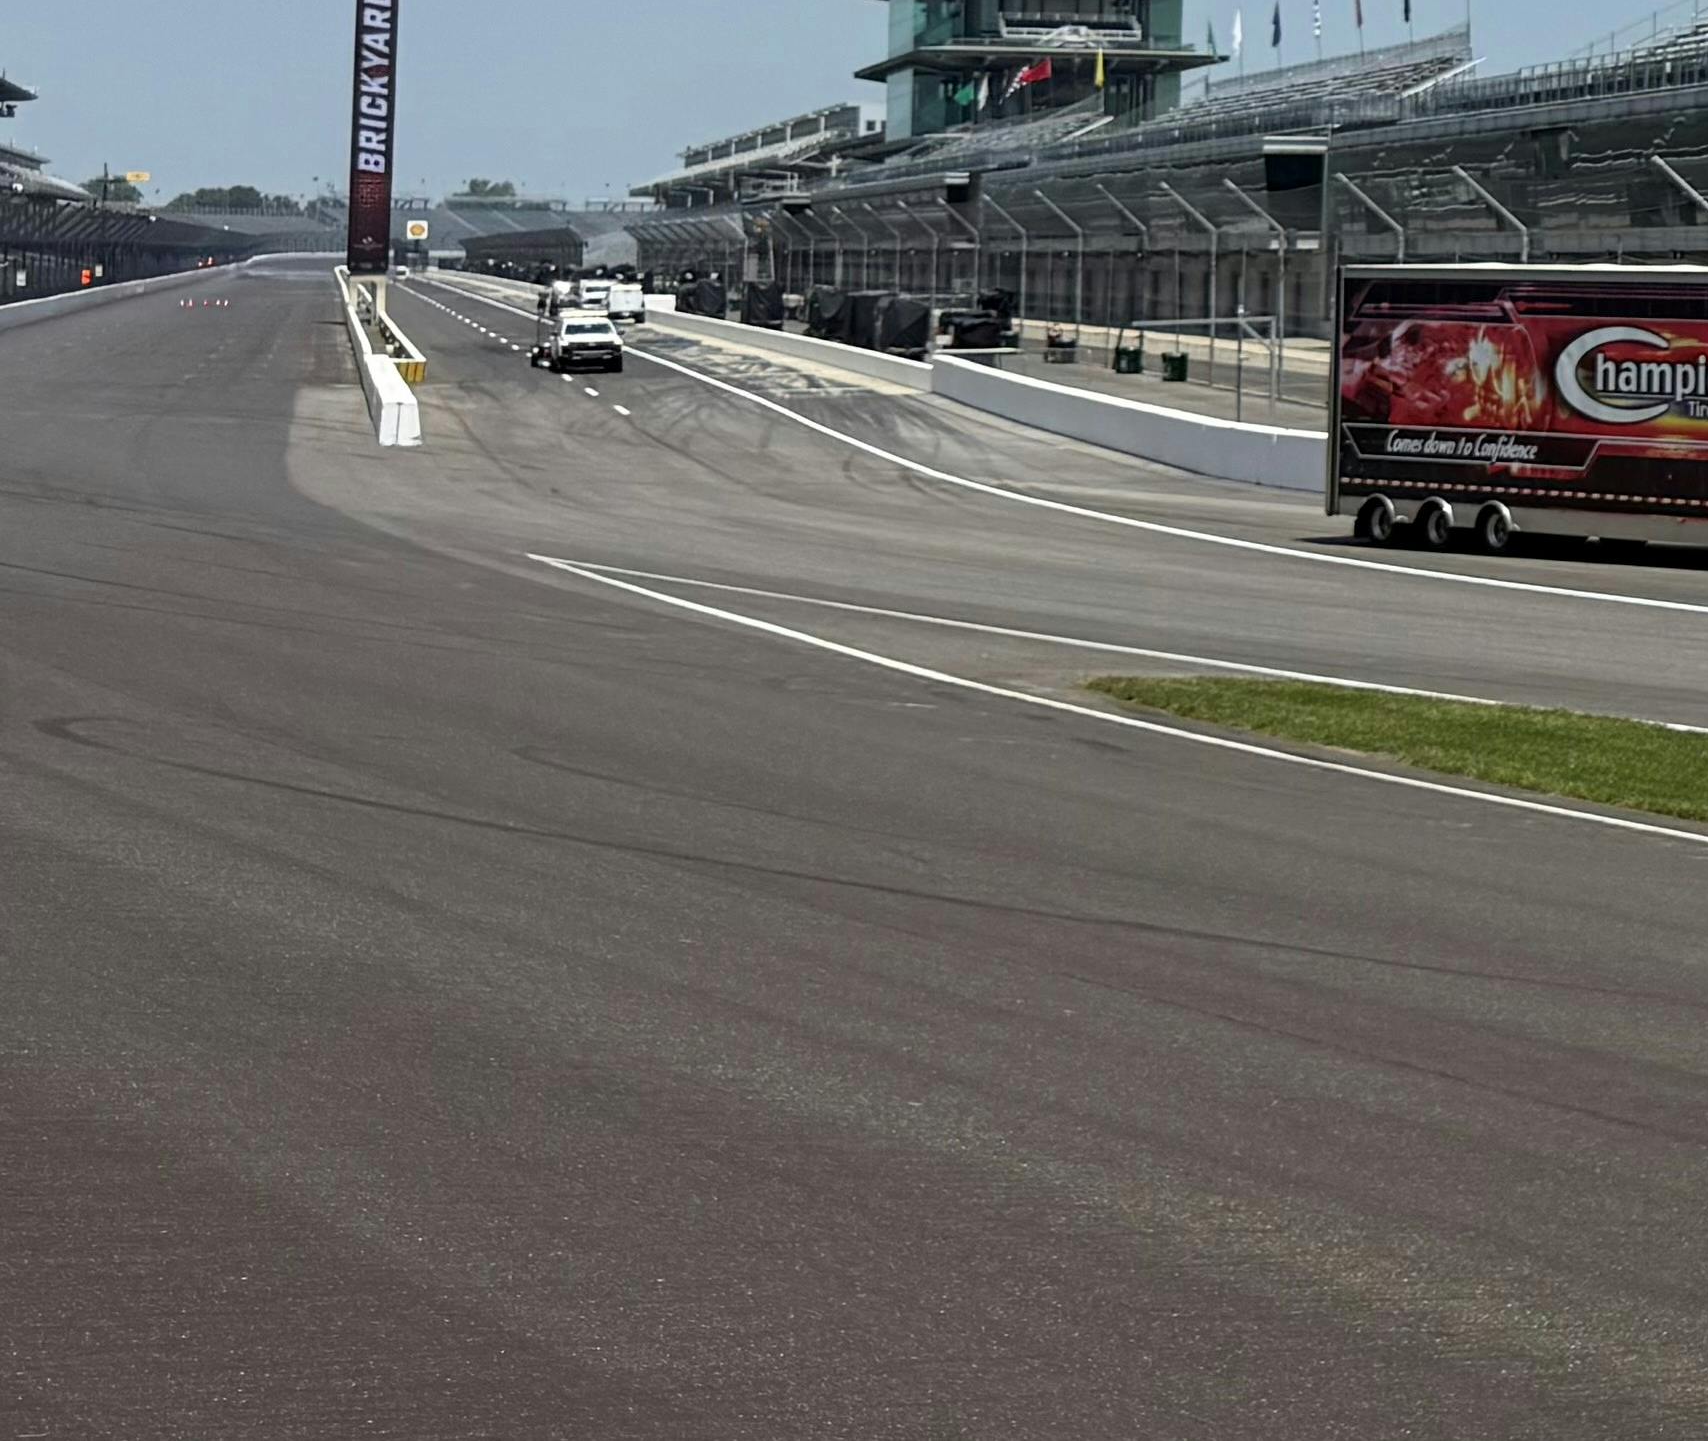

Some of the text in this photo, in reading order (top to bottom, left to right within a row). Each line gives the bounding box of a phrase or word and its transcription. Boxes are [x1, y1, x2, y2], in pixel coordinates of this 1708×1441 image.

[1386, 429, 1539, 462] Comes down to Confidence
